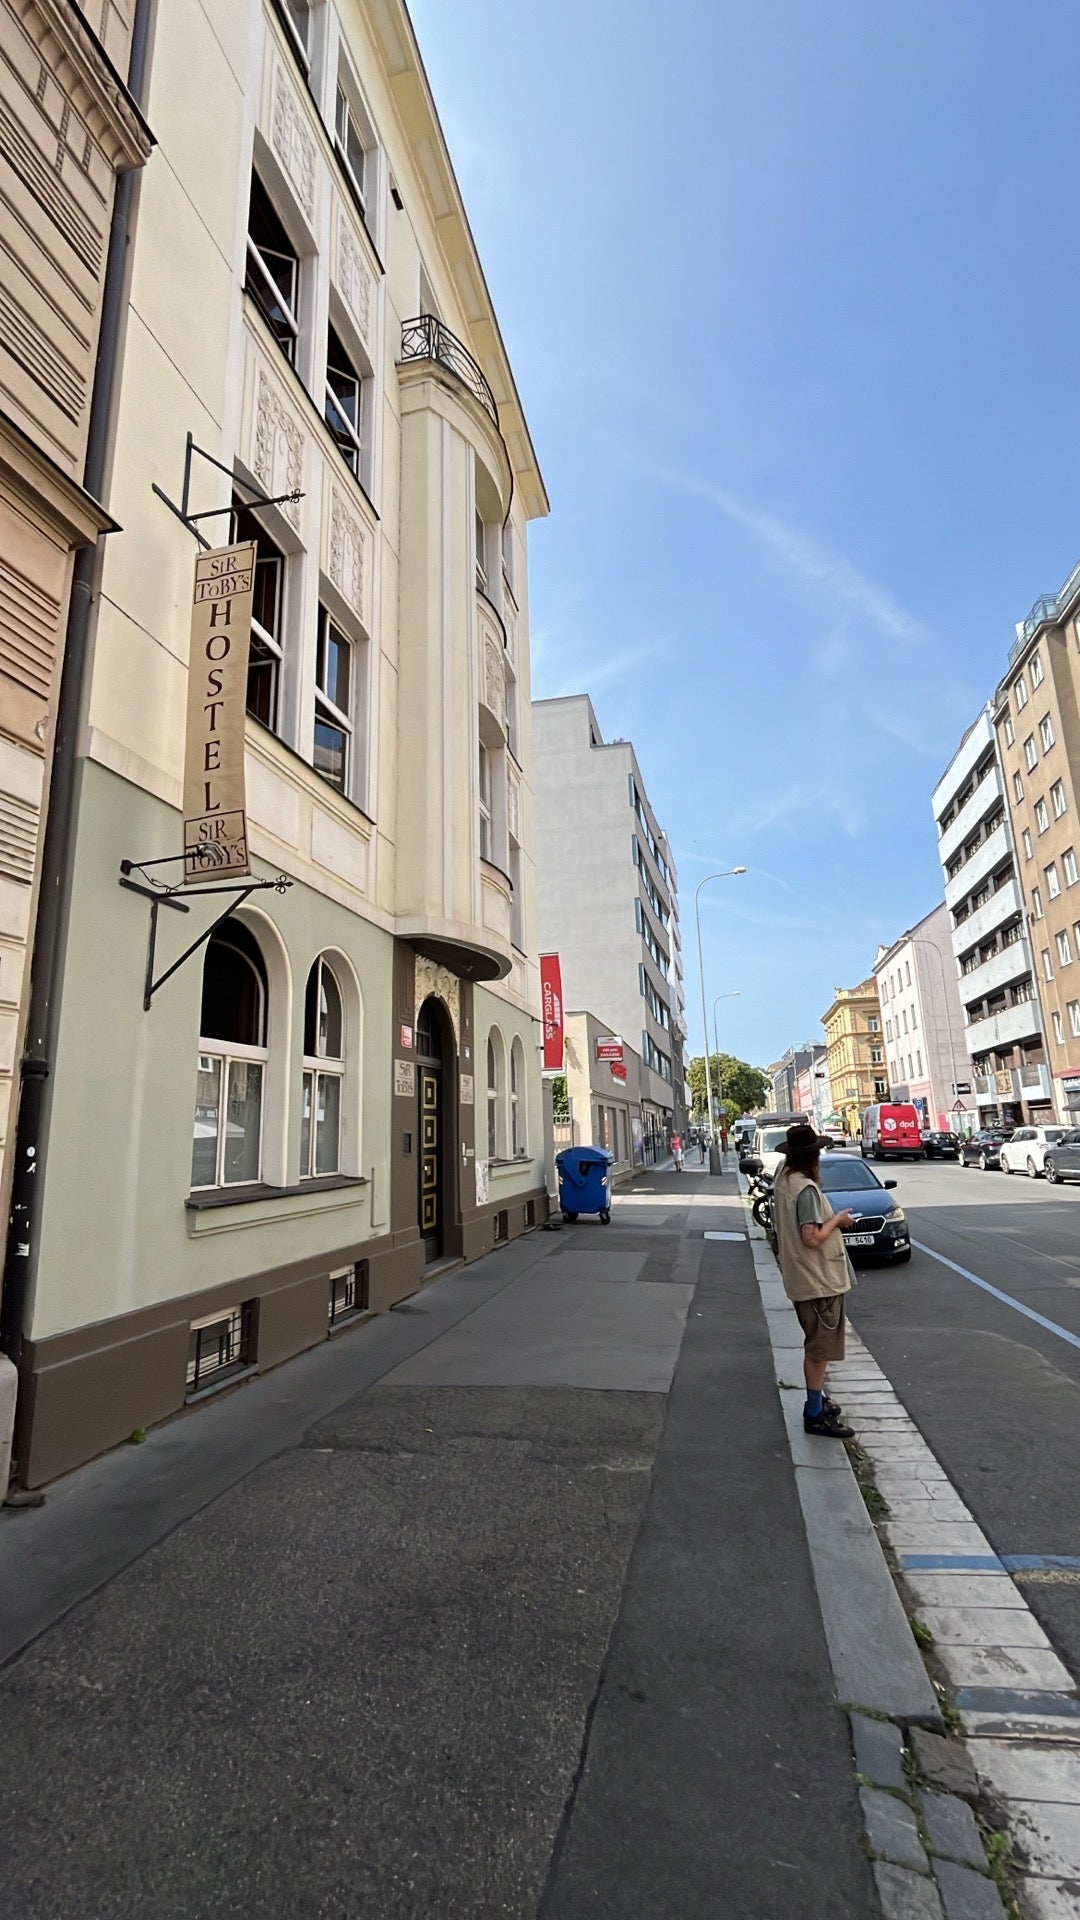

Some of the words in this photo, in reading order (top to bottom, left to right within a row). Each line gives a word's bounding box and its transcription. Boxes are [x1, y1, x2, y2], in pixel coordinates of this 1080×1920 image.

[210, 556, 237, 577] SIR
[203, 599, 232, 812] HOSTEL
[198, 819, 228, 842] SIR
[543, 981, 553, 1041] CARGLASS
[899, 1120, 915, 1129] dpd
